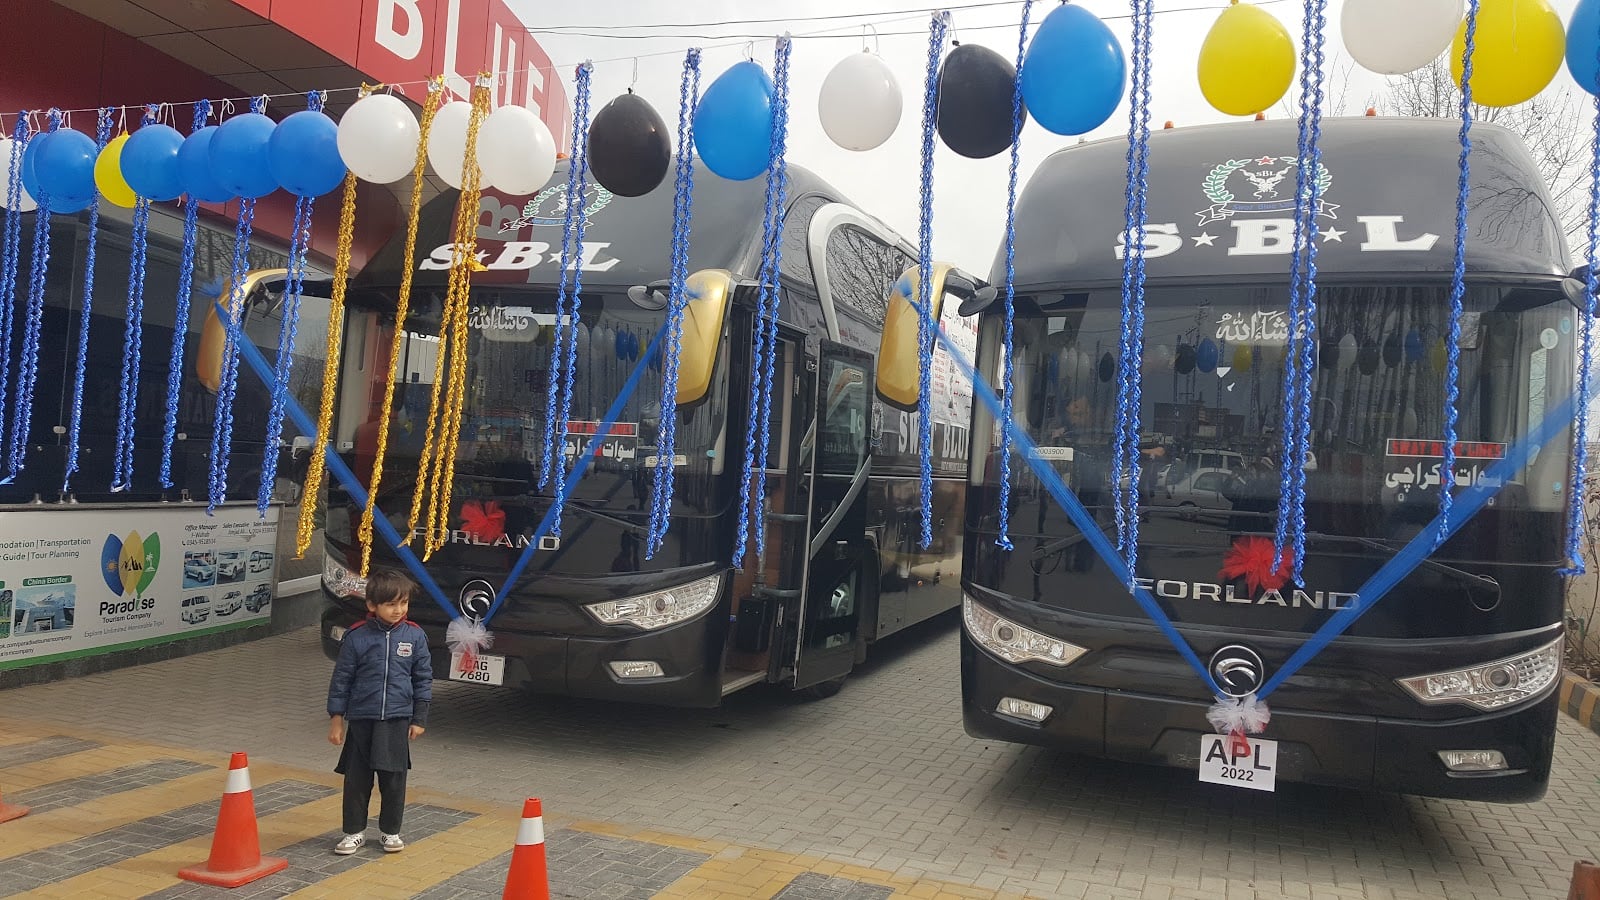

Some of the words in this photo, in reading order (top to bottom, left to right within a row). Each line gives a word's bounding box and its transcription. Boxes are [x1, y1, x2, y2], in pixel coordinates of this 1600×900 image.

[40, 537, 92, 549] Transportation
[2, 552, 26, 561] Guide
[31, 551, 48, 560] Tour
[49, 549, 80, 559] Planning
[99, 596, 155, 616] Paradise
[102, 616, 126, 624] Tourism
[126, 612, 152, 621] Company
[460, 669, 490, 682] 7680
[1205, 739, 1272, 771] APL
[1220, 766, 1254, 782] 2022
